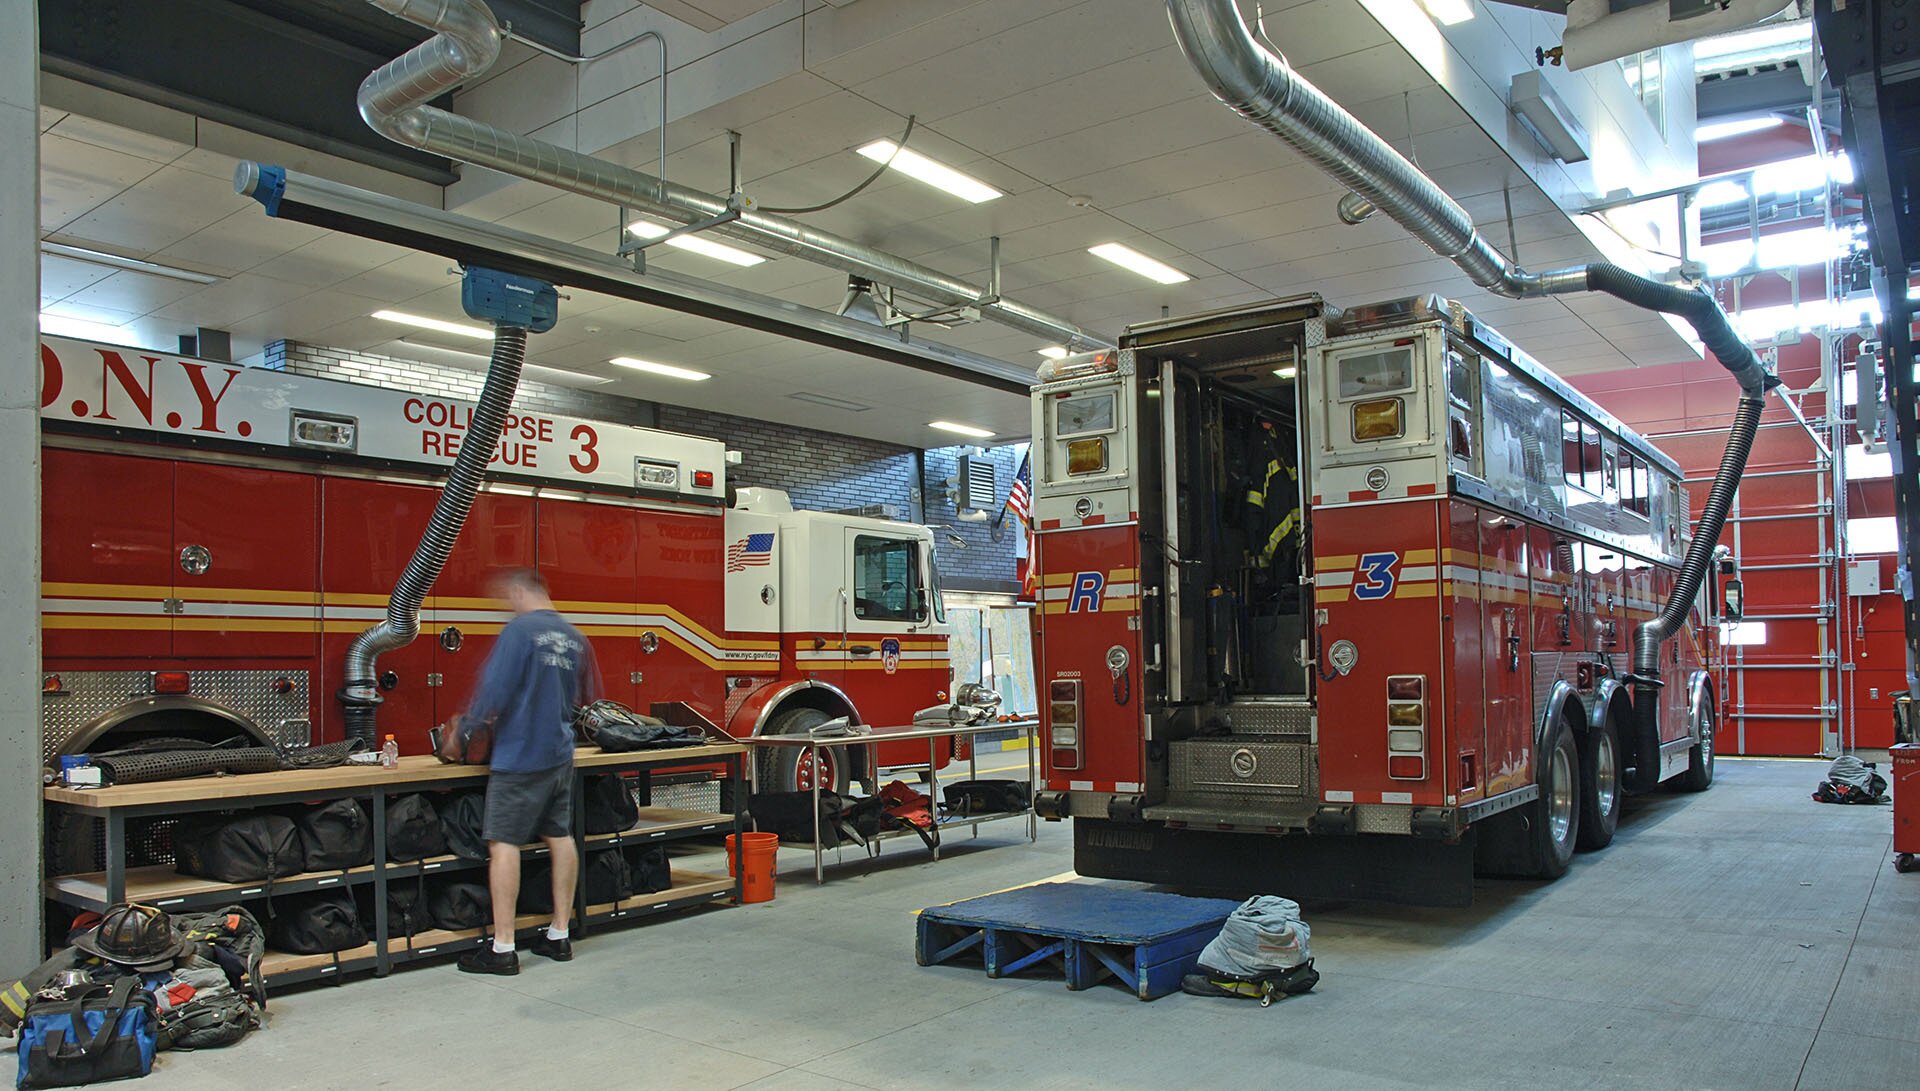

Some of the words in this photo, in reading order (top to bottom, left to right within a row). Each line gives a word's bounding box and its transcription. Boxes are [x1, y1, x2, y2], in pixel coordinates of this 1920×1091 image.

[403, 398, 553, 442] COLLPSE
[422, 430, 537, 468] RECUE
[568, 424, 600, 474] 3
[1069, 571, 1104, 613] R
[1354, 551, 1399, 600] 3
[725, 651, 778, 660] www.nyc.gov/fdny
